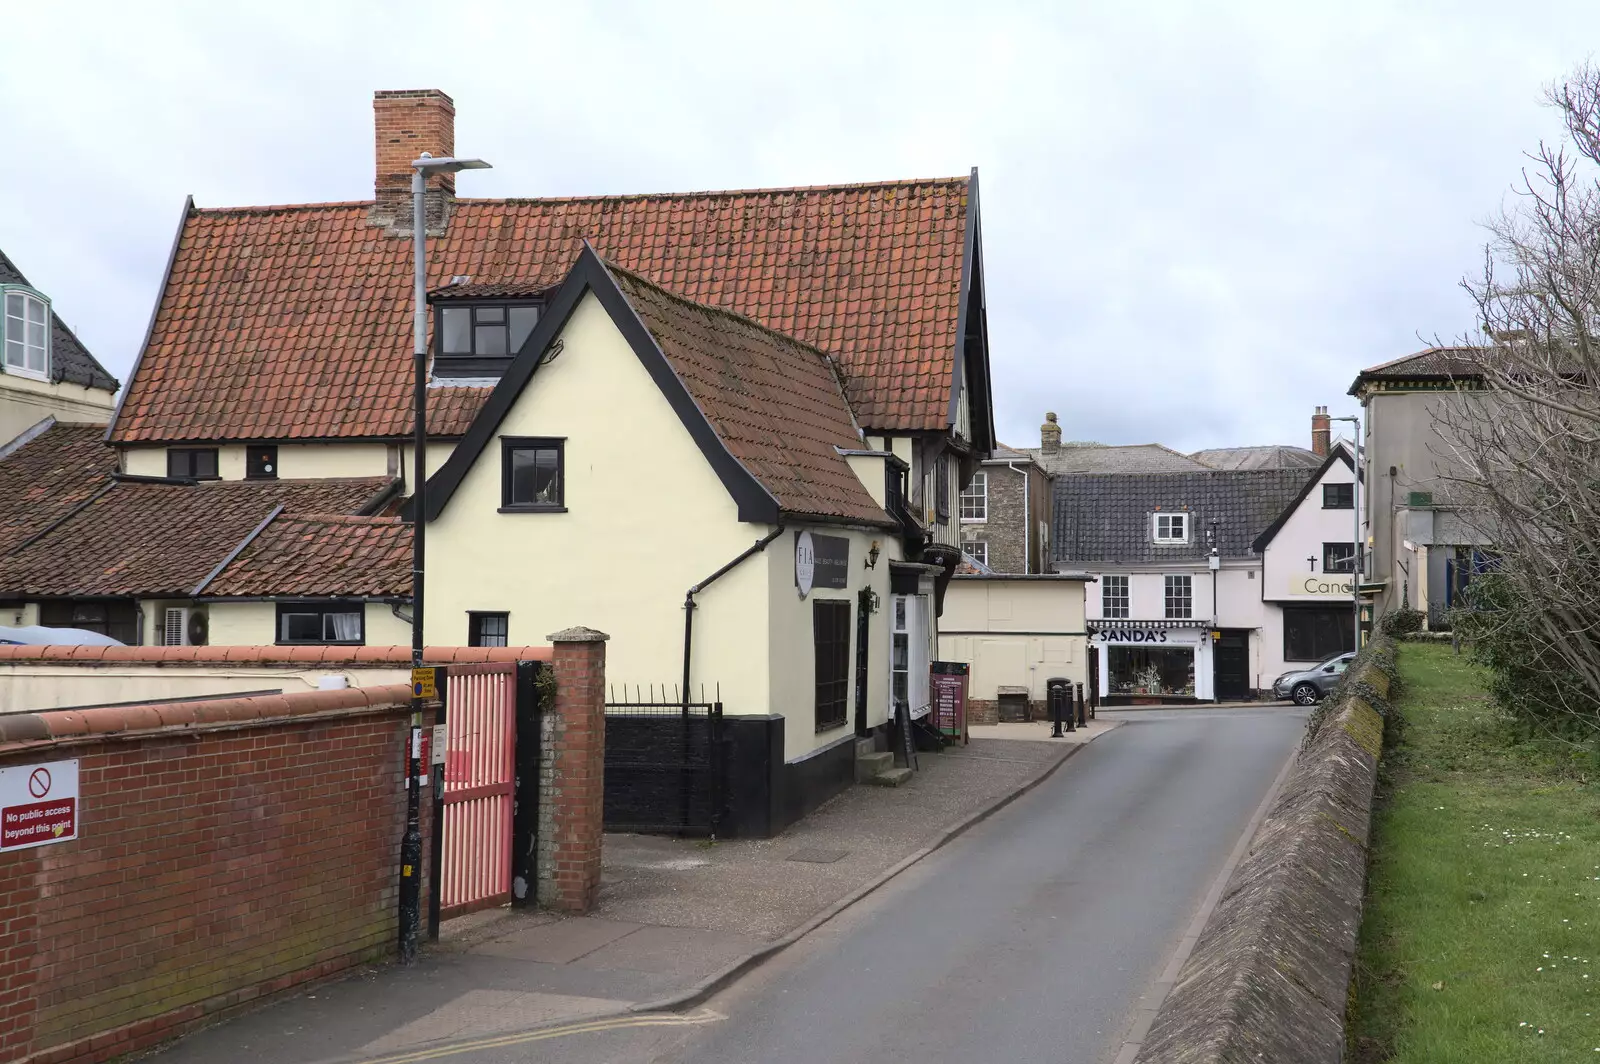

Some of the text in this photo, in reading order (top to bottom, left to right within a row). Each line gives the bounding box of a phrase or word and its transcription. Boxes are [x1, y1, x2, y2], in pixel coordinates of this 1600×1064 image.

[798, 546, 813, 565] FIA
[1100, 630, 1167, 643] SANDA'S
[6, 805, 71, 823] No public access
[5, 825, 34, 839] beyond
[35, 823, 51, 833] this
